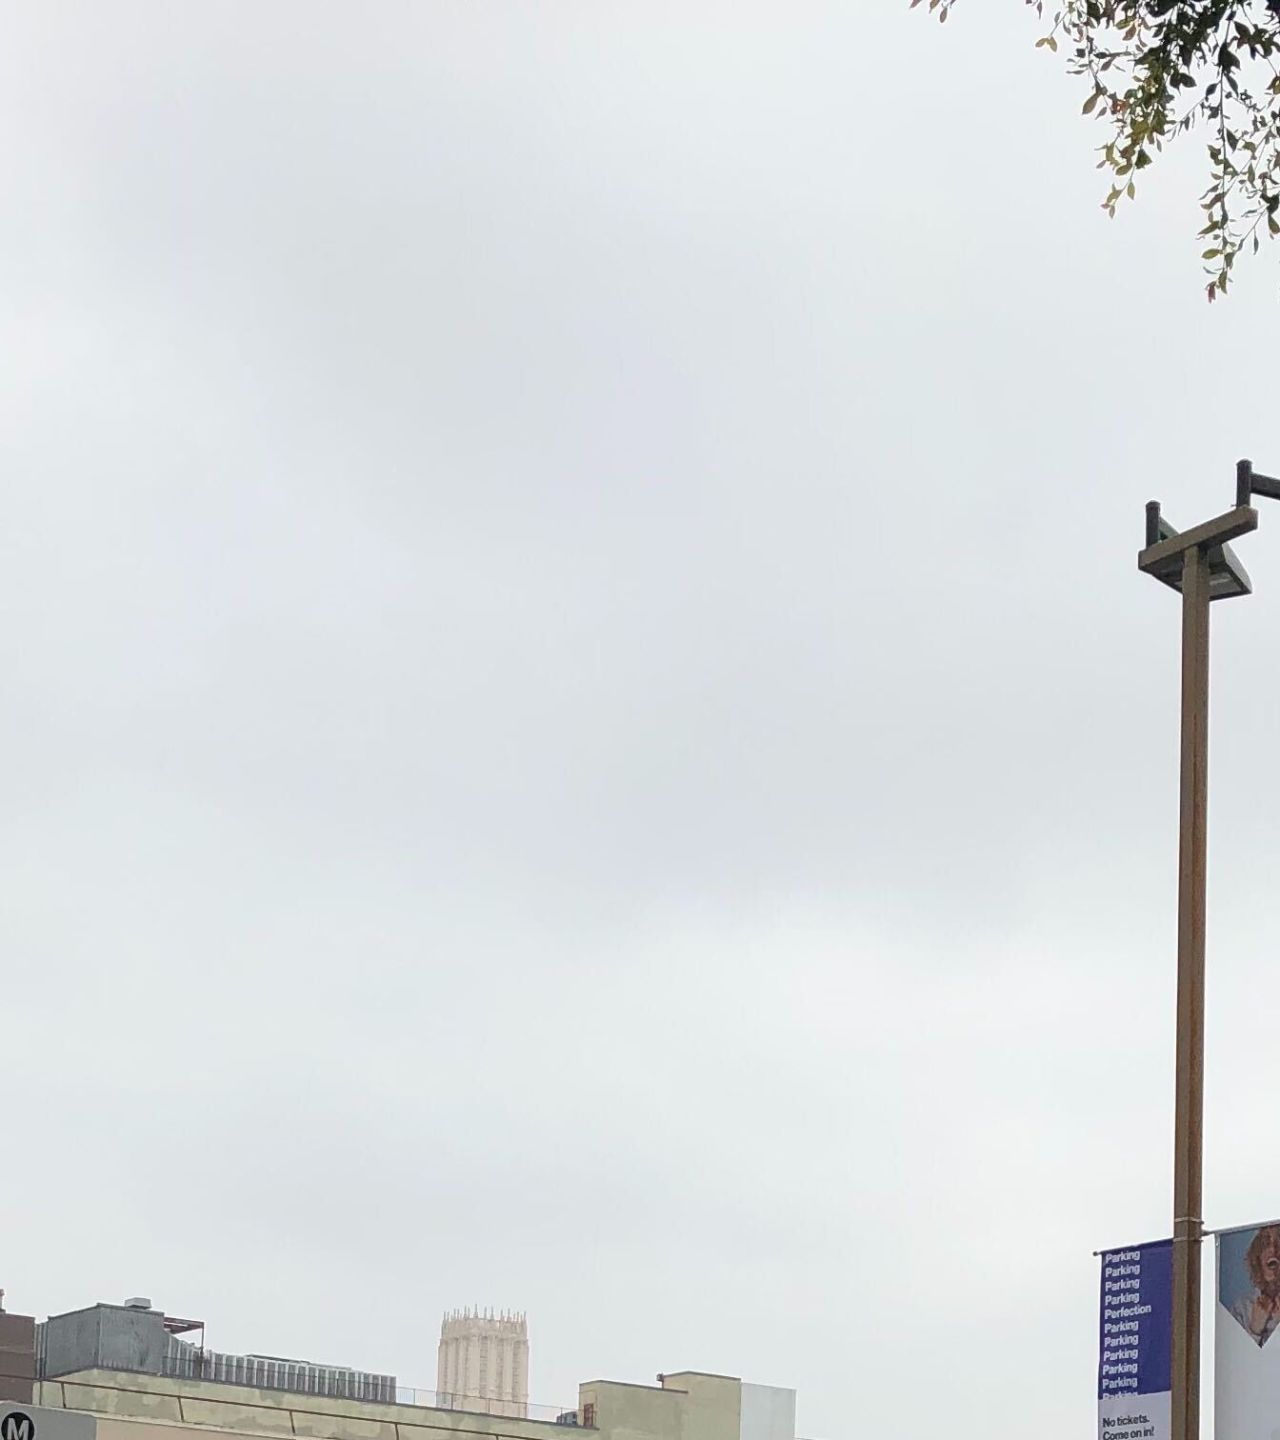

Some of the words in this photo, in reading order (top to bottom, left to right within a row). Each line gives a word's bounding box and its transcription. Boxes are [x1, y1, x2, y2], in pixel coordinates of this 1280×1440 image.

[1106, 1251, 1140, 1263] Parking
[1106, 1264, 1140, 1277] Parking
[1105, 1278, 1140, 1292] Parking
[1105, 1293, 1139, 1306] Parking
[1104, 1305, 1152, 1319] Perfection
[1104, 1320, 1138, 1334] Parking
[1104, 1334, 1138, 1347] Parking
[1104, 1348, 1138, 1361] Parking
[1103, 1363, 1138, 1375] Parking
[1103, 1376, 1138, 1389] Parking
[1103, 1418, 1116, 1428] No
[1117, 1414, 1150, 1426] tickets.
[1103, 1431, 1128, 1440] Come
[1144, 1426, 1154, 1436] in!
